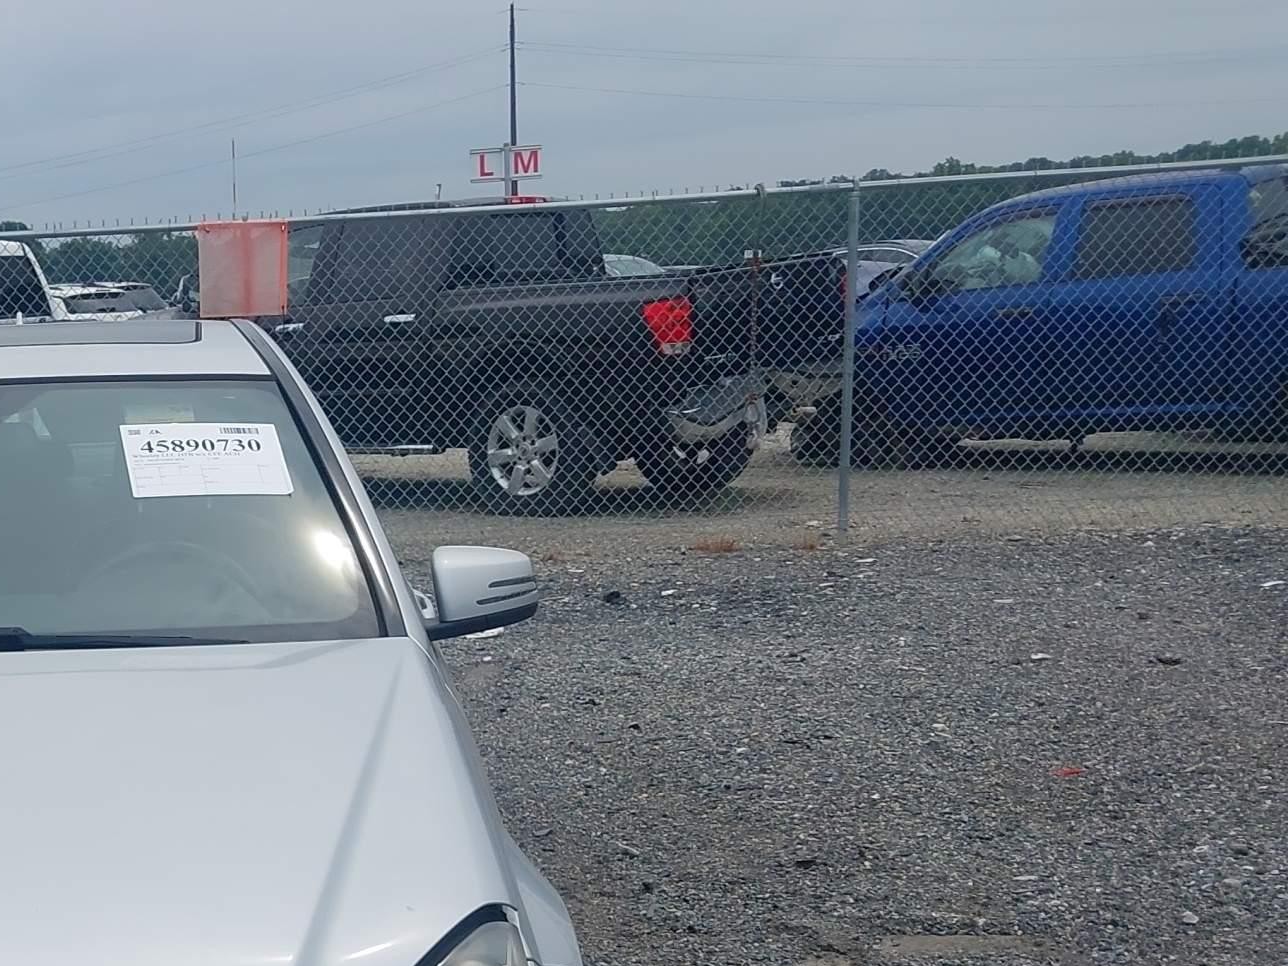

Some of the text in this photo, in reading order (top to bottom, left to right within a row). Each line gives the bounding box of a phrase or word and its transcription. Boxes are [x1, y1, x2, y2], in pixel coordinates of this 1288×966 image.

[479, 153, 494, 177] L
[513, 150, 539, 175] M
[140, 438, 261, 454] 45890730
